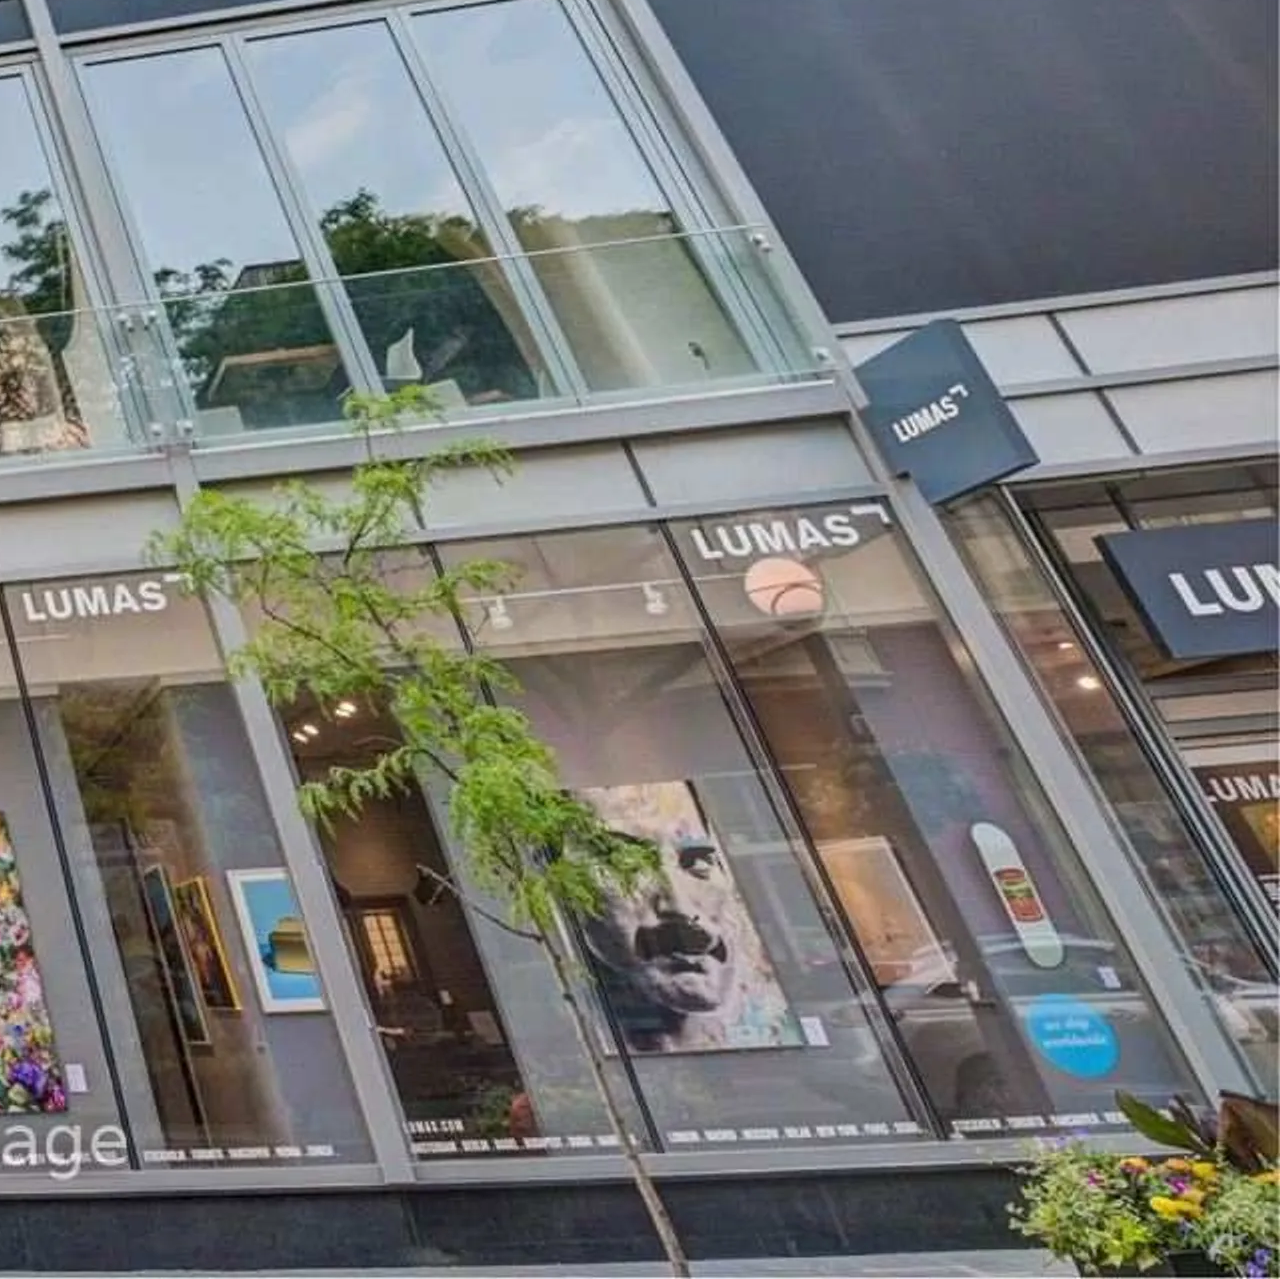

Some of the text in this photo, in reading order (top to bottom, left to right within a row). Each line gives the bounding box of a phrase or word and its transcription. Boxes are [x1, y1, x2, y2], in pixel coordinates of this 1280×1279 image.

[892, 395, 960, 443] LUMAS
[690, 514, 860, 560] LUMAS
[21, 580, 168, 622] LUMAS
